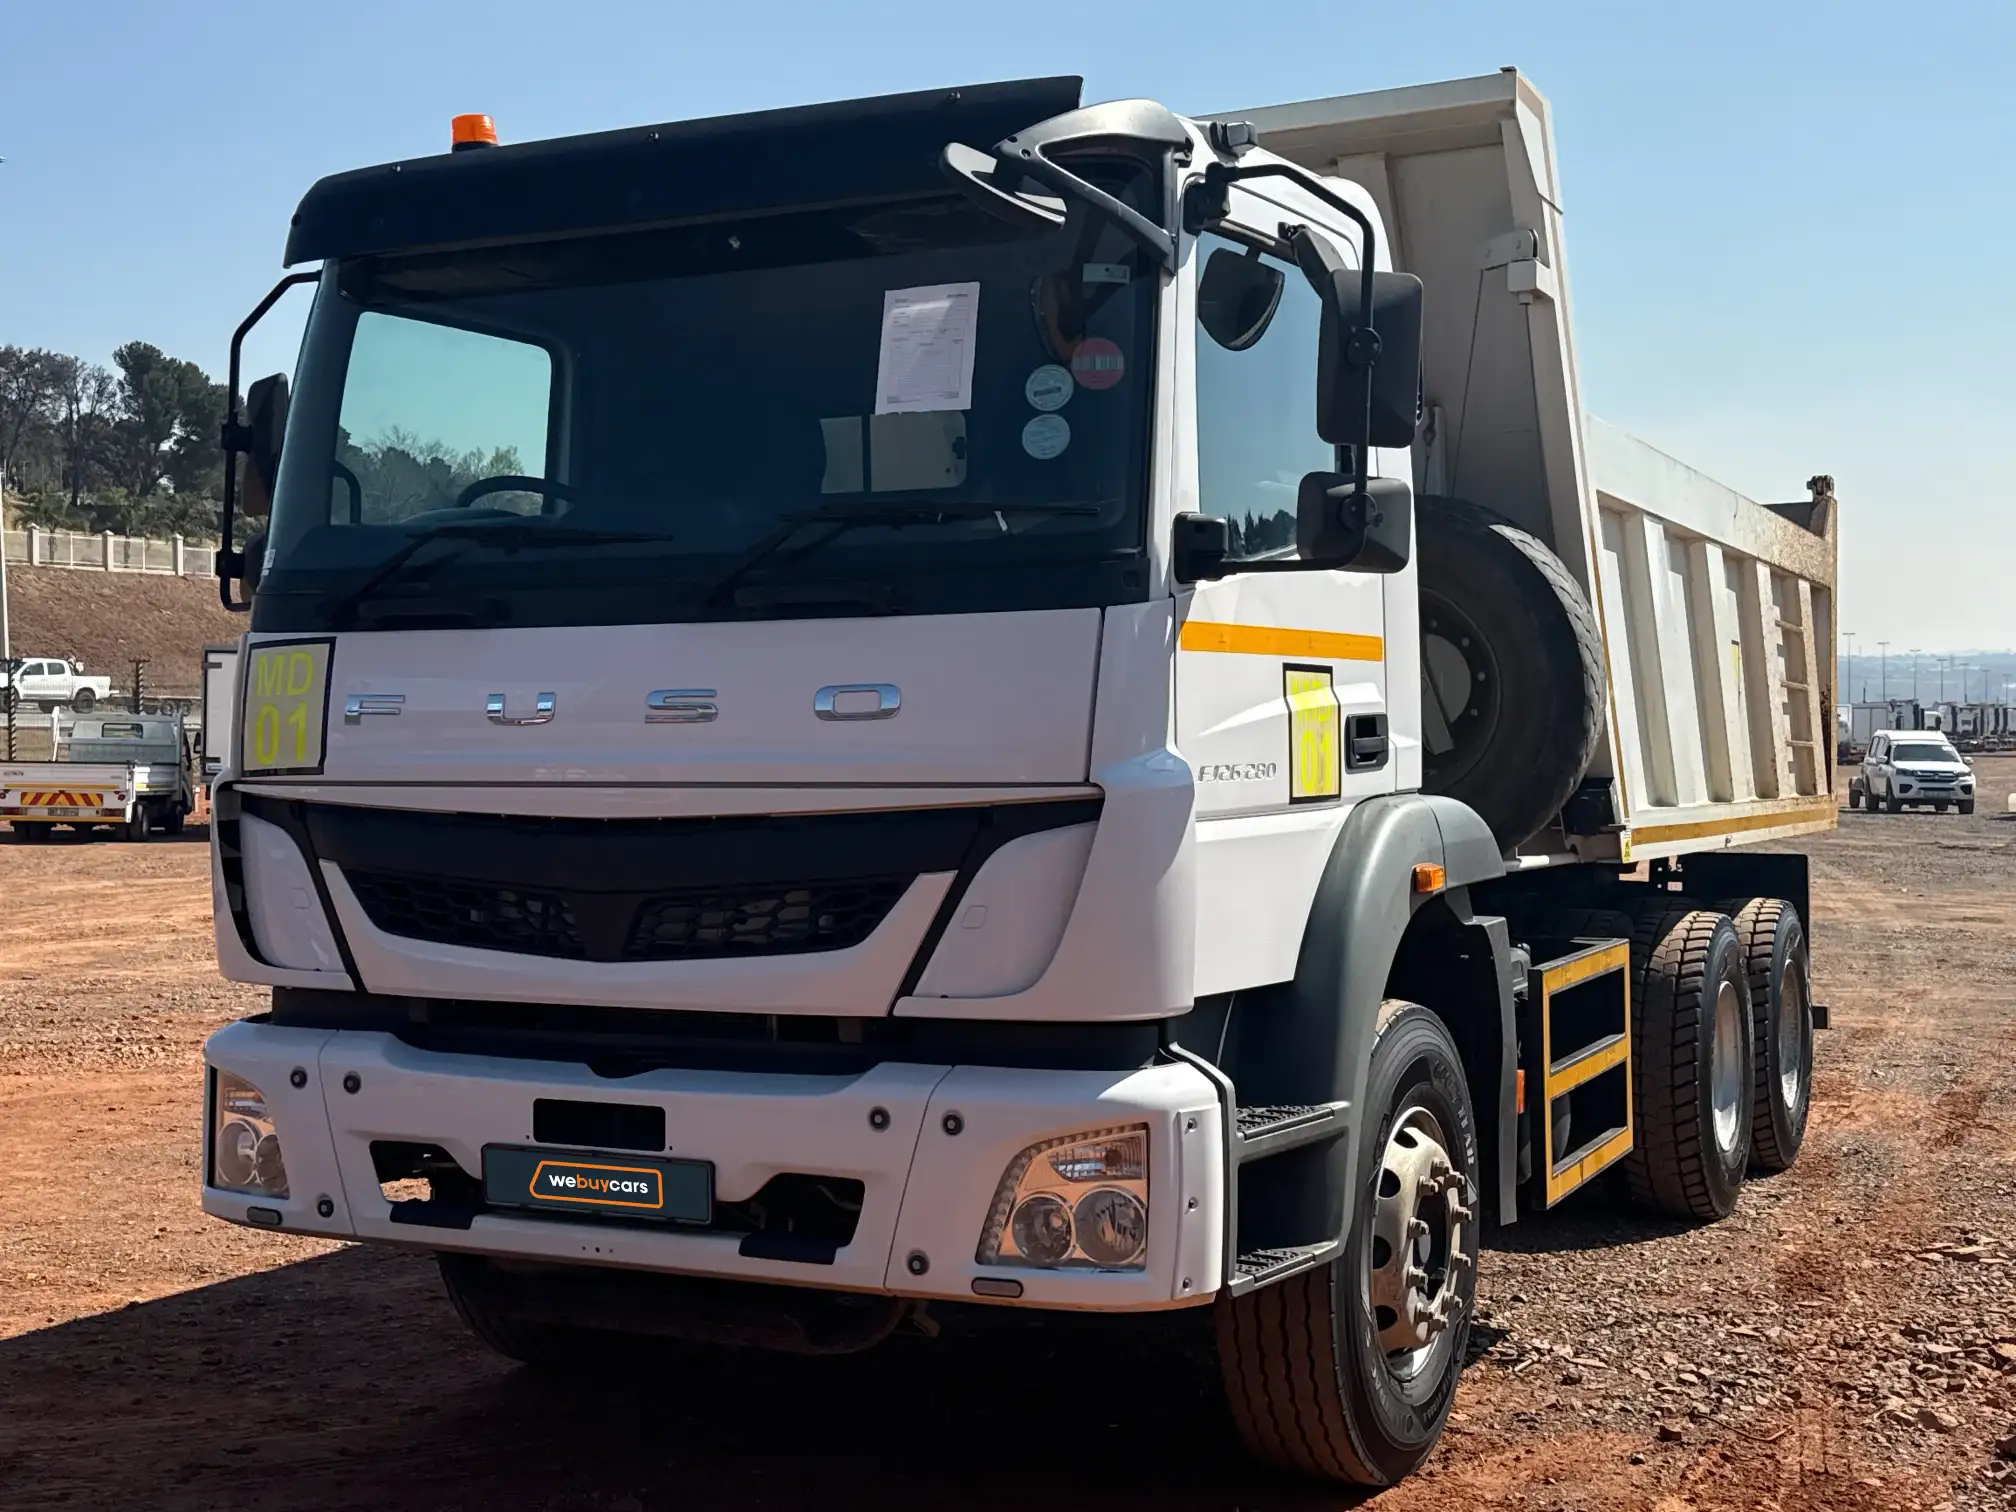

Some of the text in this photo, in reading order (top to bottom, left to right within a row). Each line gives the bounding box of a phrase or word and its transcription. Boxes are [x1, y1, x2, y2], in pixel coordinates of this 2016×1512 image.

[256, 651, 314, 697] MD
[344, 683, 902, 726] FUSO
[1292, 679, 1332, 723] MD
[255, 700, 308, 767] 01
[1301, 728, 1331, 794] 01
[548, 1173, 649, 1194] webuycars
